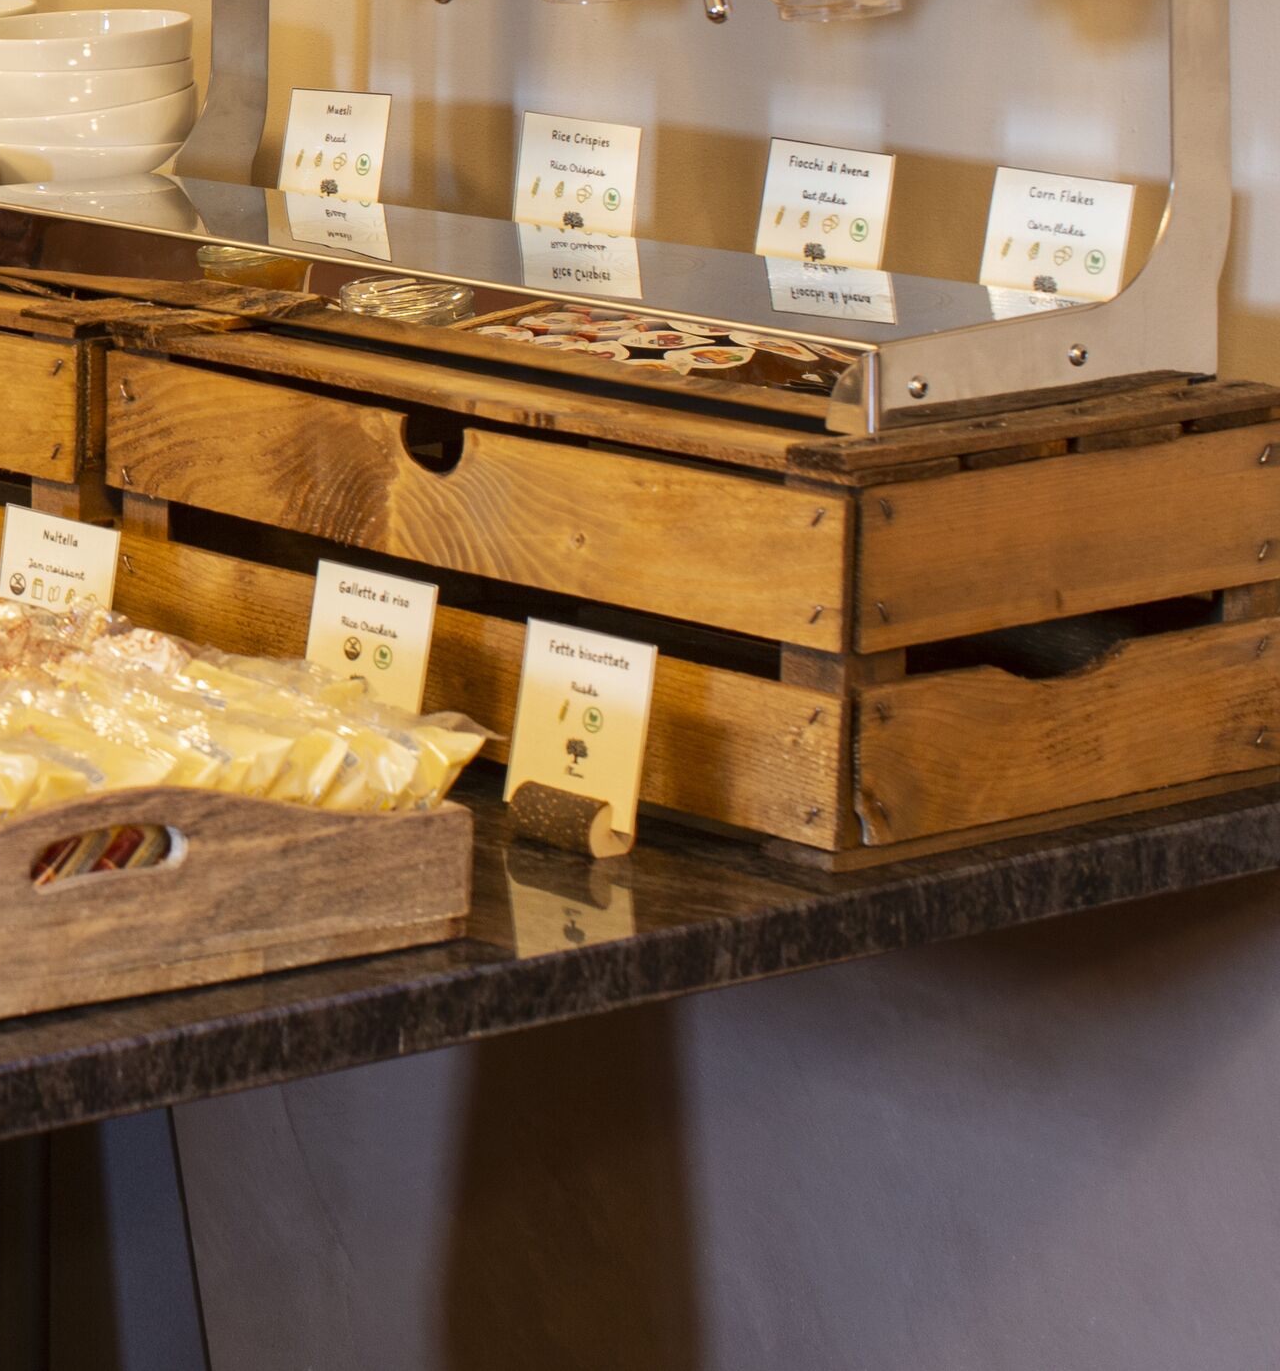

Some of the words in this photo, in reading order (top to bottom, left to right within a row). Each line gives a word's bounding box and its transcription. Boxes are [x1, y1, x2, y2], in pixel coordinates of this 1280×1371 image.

[326, 104, 352, 116] Muesli
[324, 133, 347, 144] Bread
[551, 129, 571, 143] Rice
[574, 132, 611, 151] Crispies
[550, 160, 569, 172] Rice
[569, 163, 607, 178] Crispies
[789, 154, 824, 172] Fiocchi
[826, 158, 837, 173] di
[839, 162, 870, 178] Avena
[816, 191, 848, 206] flakes
[1028, 186, 1057, 200] Corn
[1059, 189, 1095, 206] Flakes
[1027, 219, 1052, 232] Corn
[1053, 222, 1087, 238] flakes
[42, 529, 79, 547] Nultella
[338, 580, 377, 601] Gallette
[379, 589, 390, 603] di
[392, 595, 410, 609] riso
[340, 614, 359, 630] Rice
[549, 638, 575, 658] Fette
[578, 645, 630, 671] biscottate
